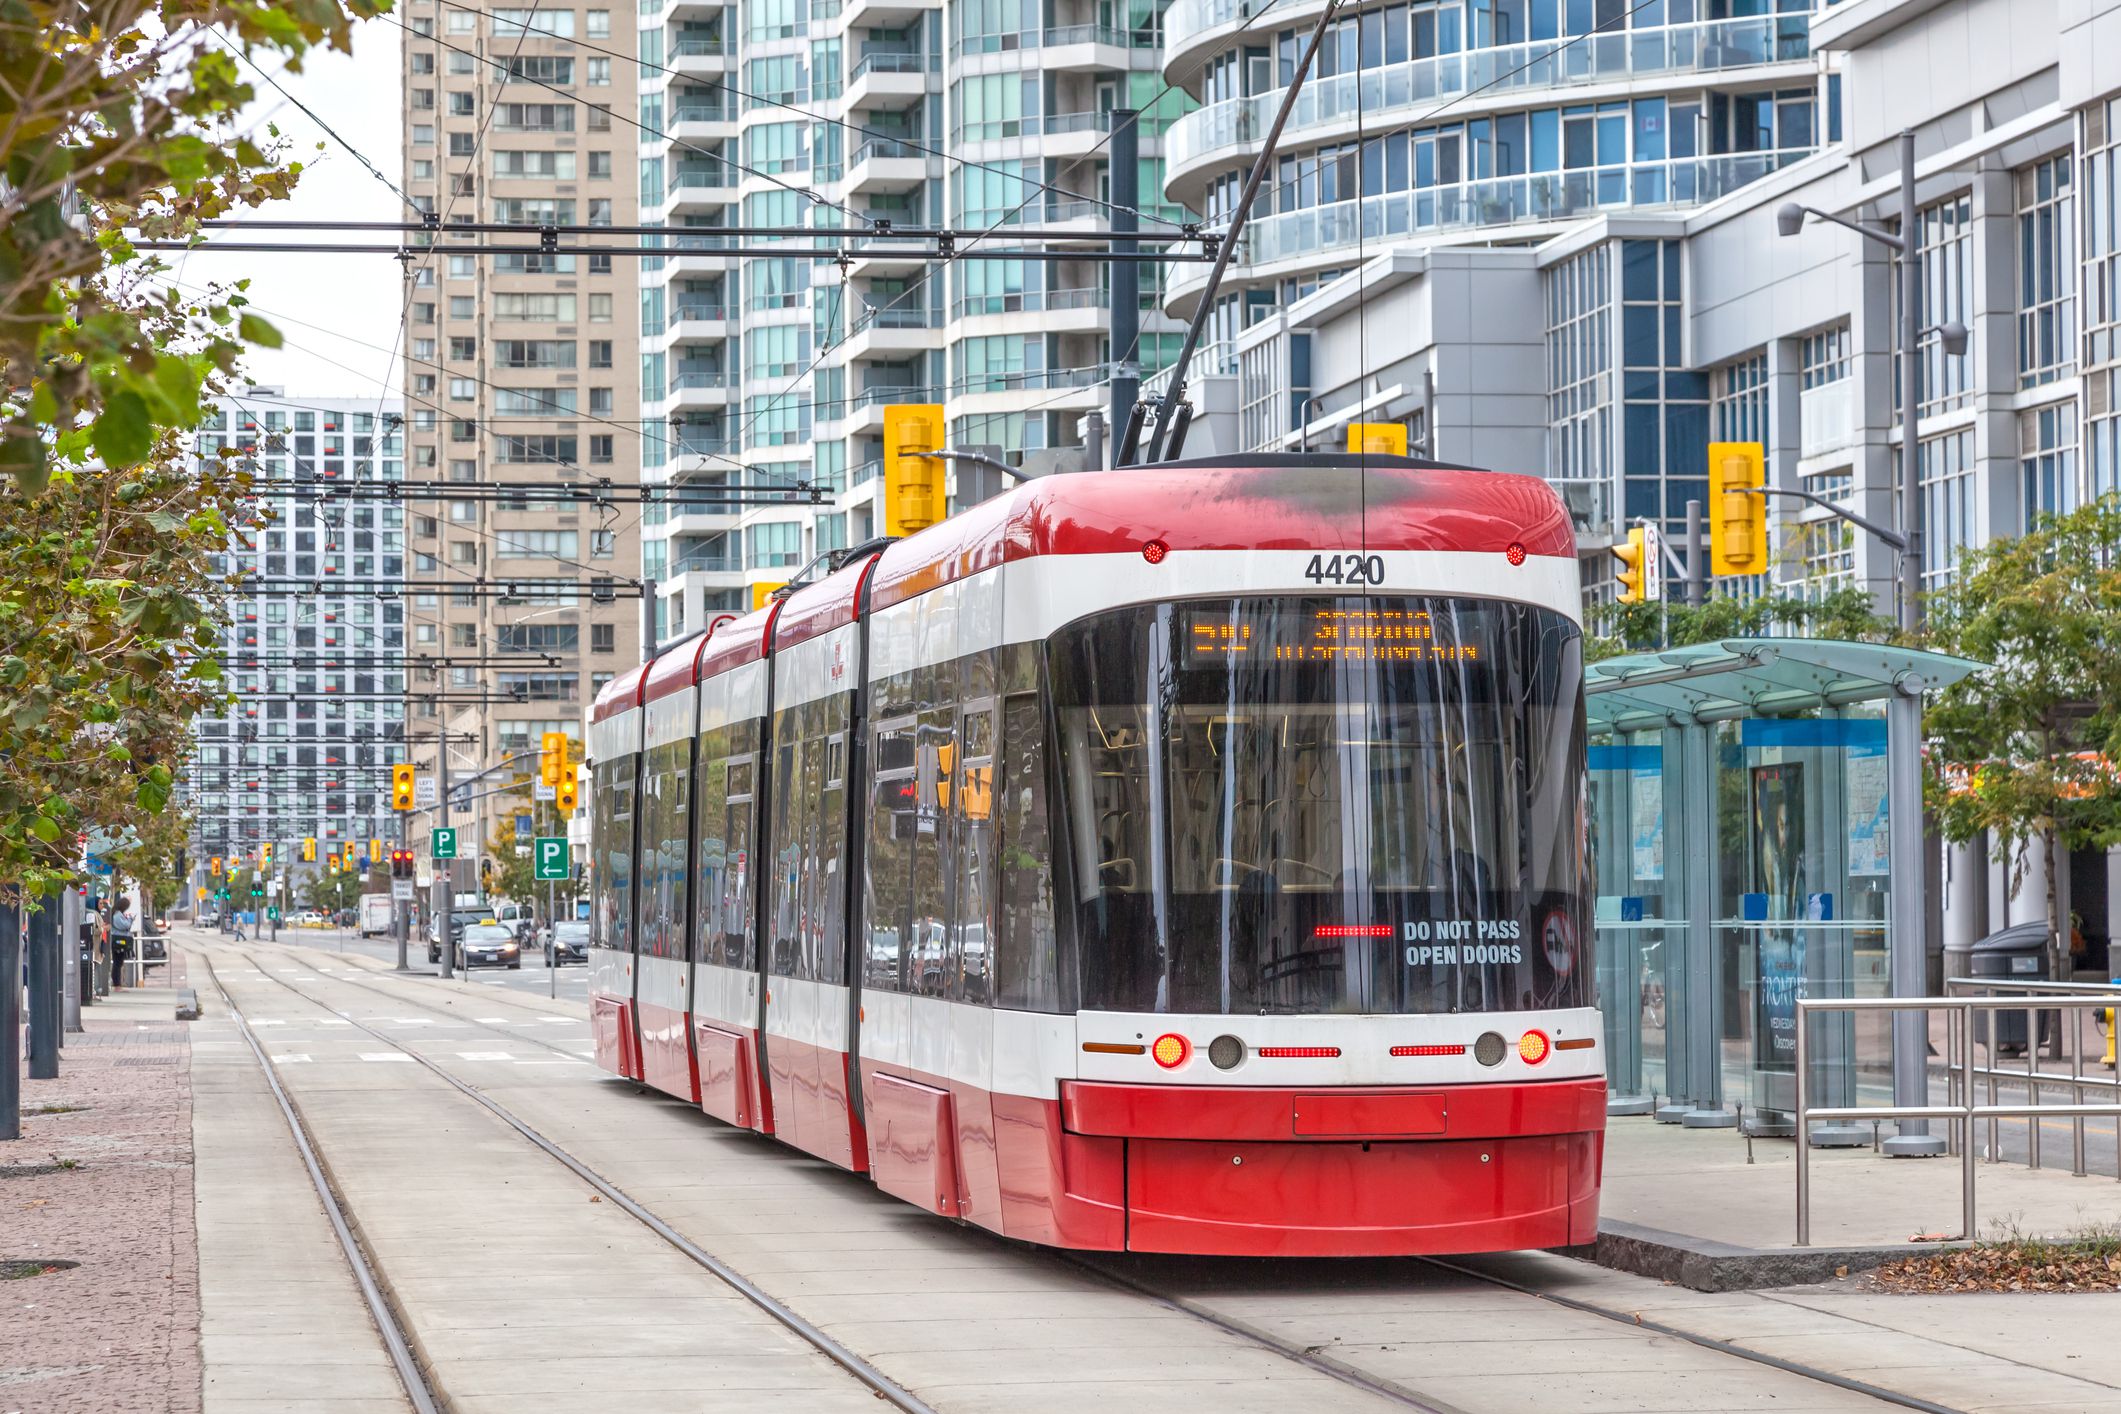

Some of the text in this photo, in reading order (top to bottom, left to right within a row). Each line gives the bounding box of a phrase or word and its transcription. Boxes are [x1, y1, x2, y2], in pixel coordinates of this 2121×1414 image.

[1305, 554, 1385, 586] 4420
[438, 831, 451, 848] P
[543, 842, 561, 865] P
[1404, 920, 1520, 940] DO NOT PASS
[1406, 945, 1521, 966] OPEN DOORS
